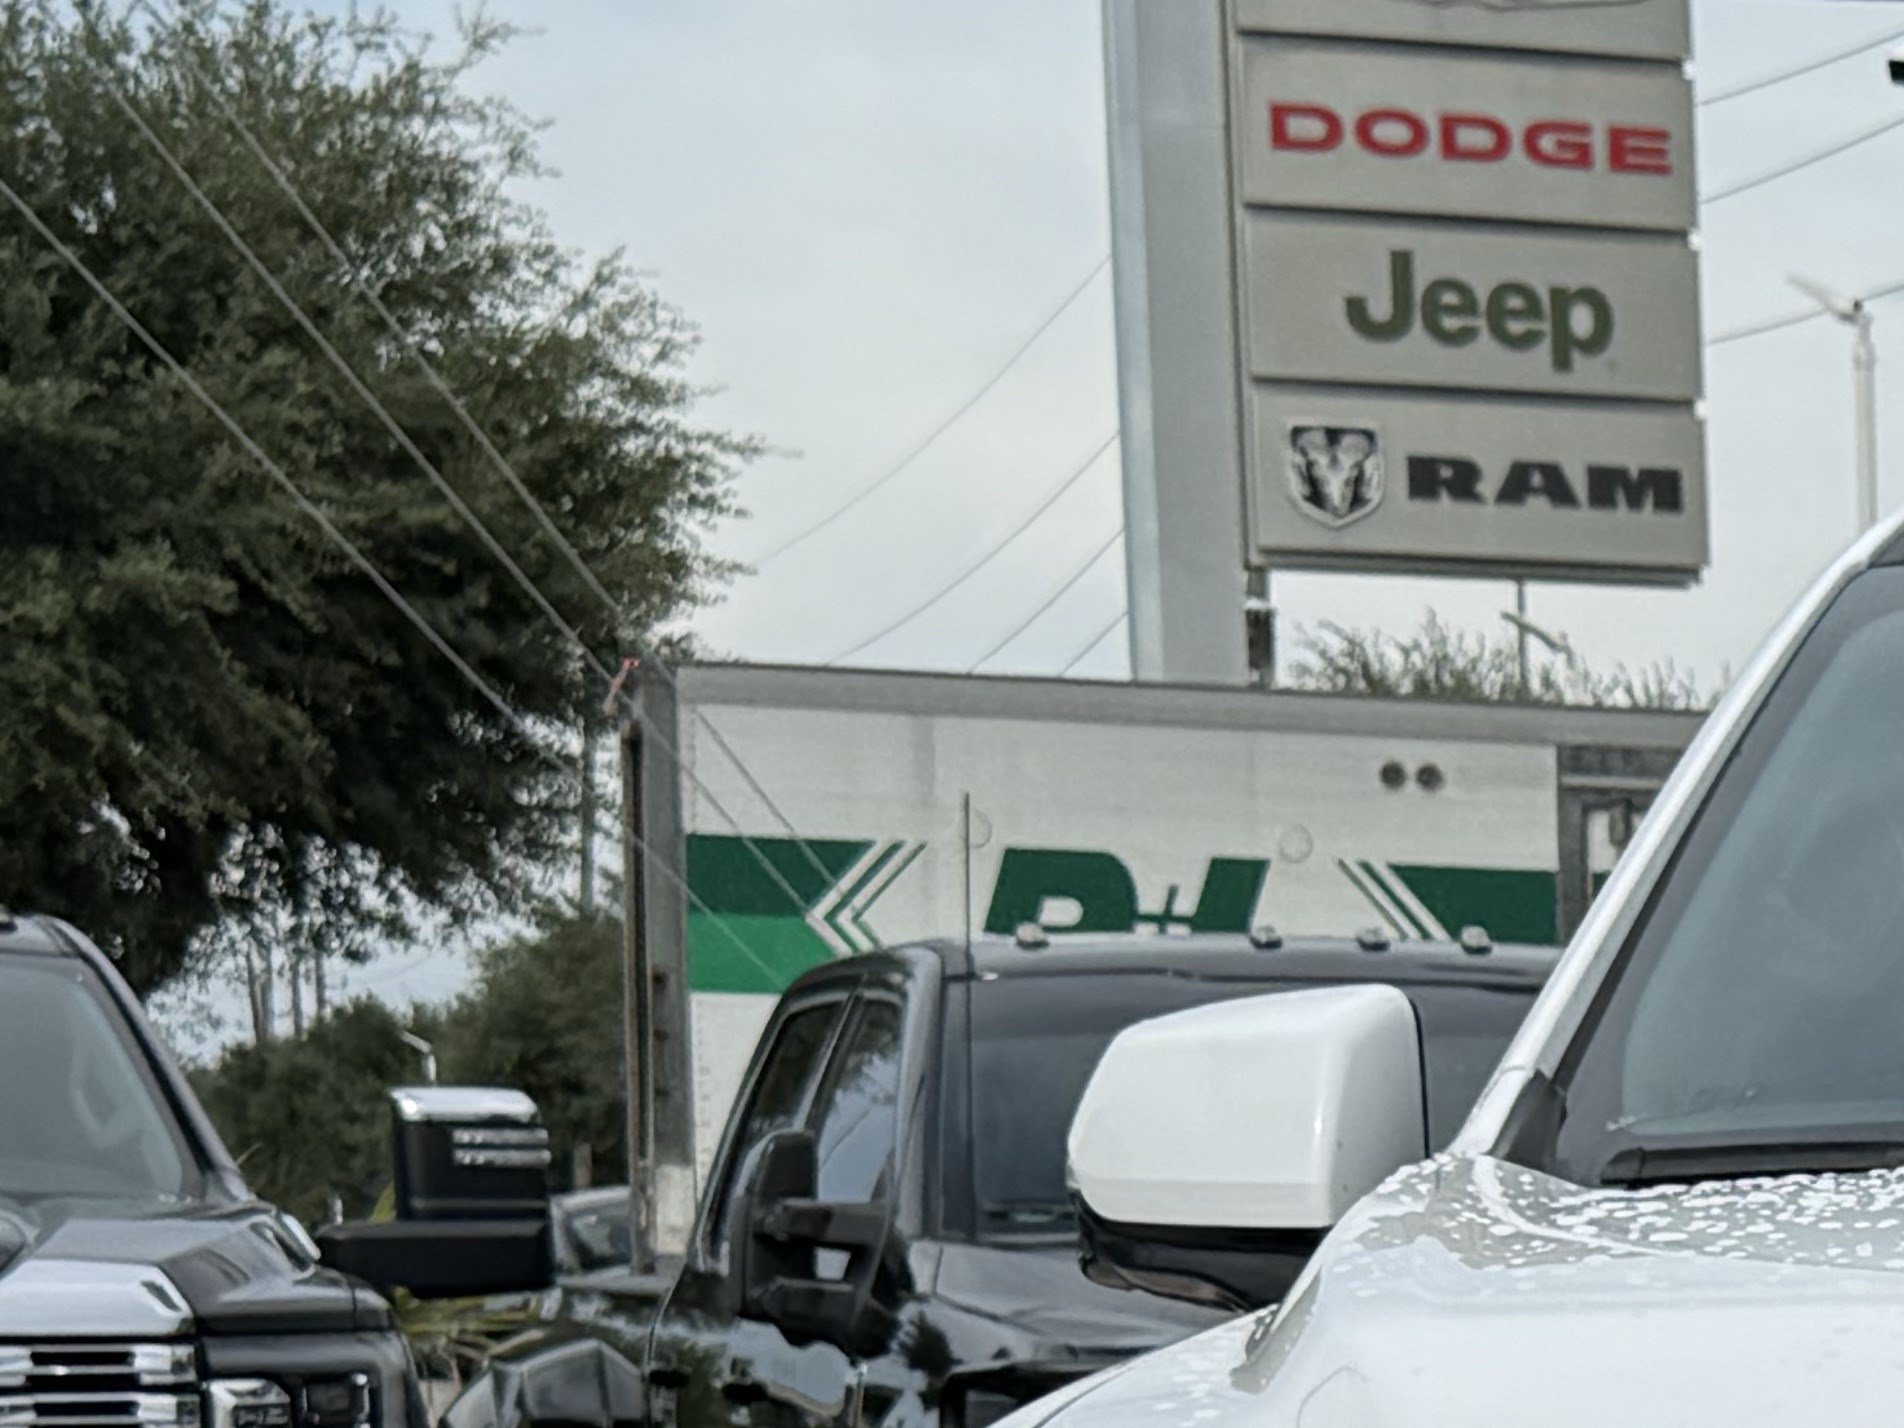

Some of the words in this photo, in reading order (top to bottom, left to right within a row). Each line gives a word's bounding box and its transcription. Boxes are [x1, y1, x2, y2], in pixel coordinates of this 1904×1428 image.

[1268, 100, 1673, 176] DODGE
[1345, 248, 1615, 372] Jeep
[1406, 455, 1684, 514] RAM
